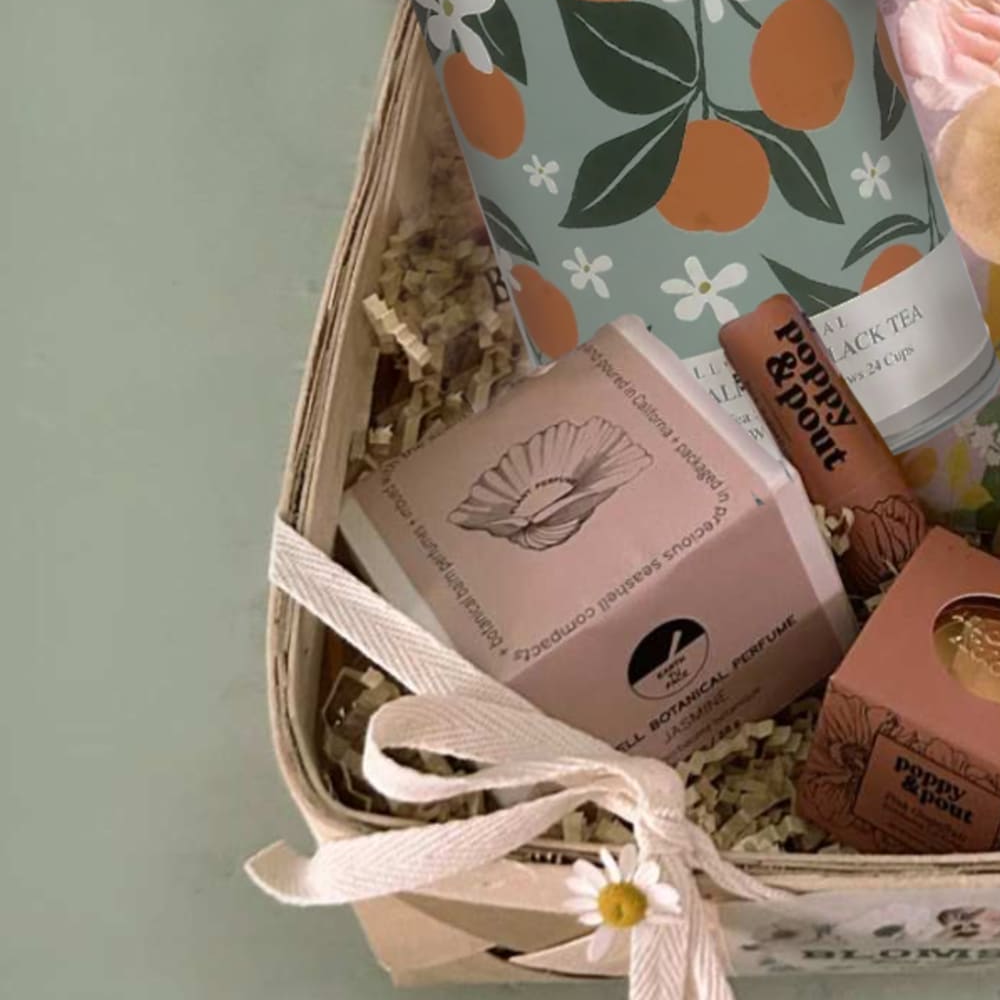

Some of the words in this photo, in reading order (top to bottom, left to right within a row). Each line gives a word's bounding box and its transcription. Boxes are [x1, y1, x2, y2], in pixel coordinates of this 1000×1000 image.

[828, 324, 885, 363] LACK
[886, 303, 924, 333] TEA
[866, 359, 882, 376] 24
[883, 344, 915, 367] Cups
[597, 358, 631, 391] poured
[624, 387, 637, 399] in
[774, 319, 857, 427] poppy
[632, 393, 674, 439] California
[675, 442, 724, 490] packaged
[717, 484, 730, 503] in
[662, 505, 728, 562] precious
[599, 557, 663, 615] seashell
[458, 595, 504, 651] botanical
[513, 606, 597, 662] compacts
[648, 671, 730, 732] BOTANICAL
[731, 613, 798, 671] PERFUME
[663, 688, 730, 744] JASMINE
[894, 755, 967, 802] poppy
